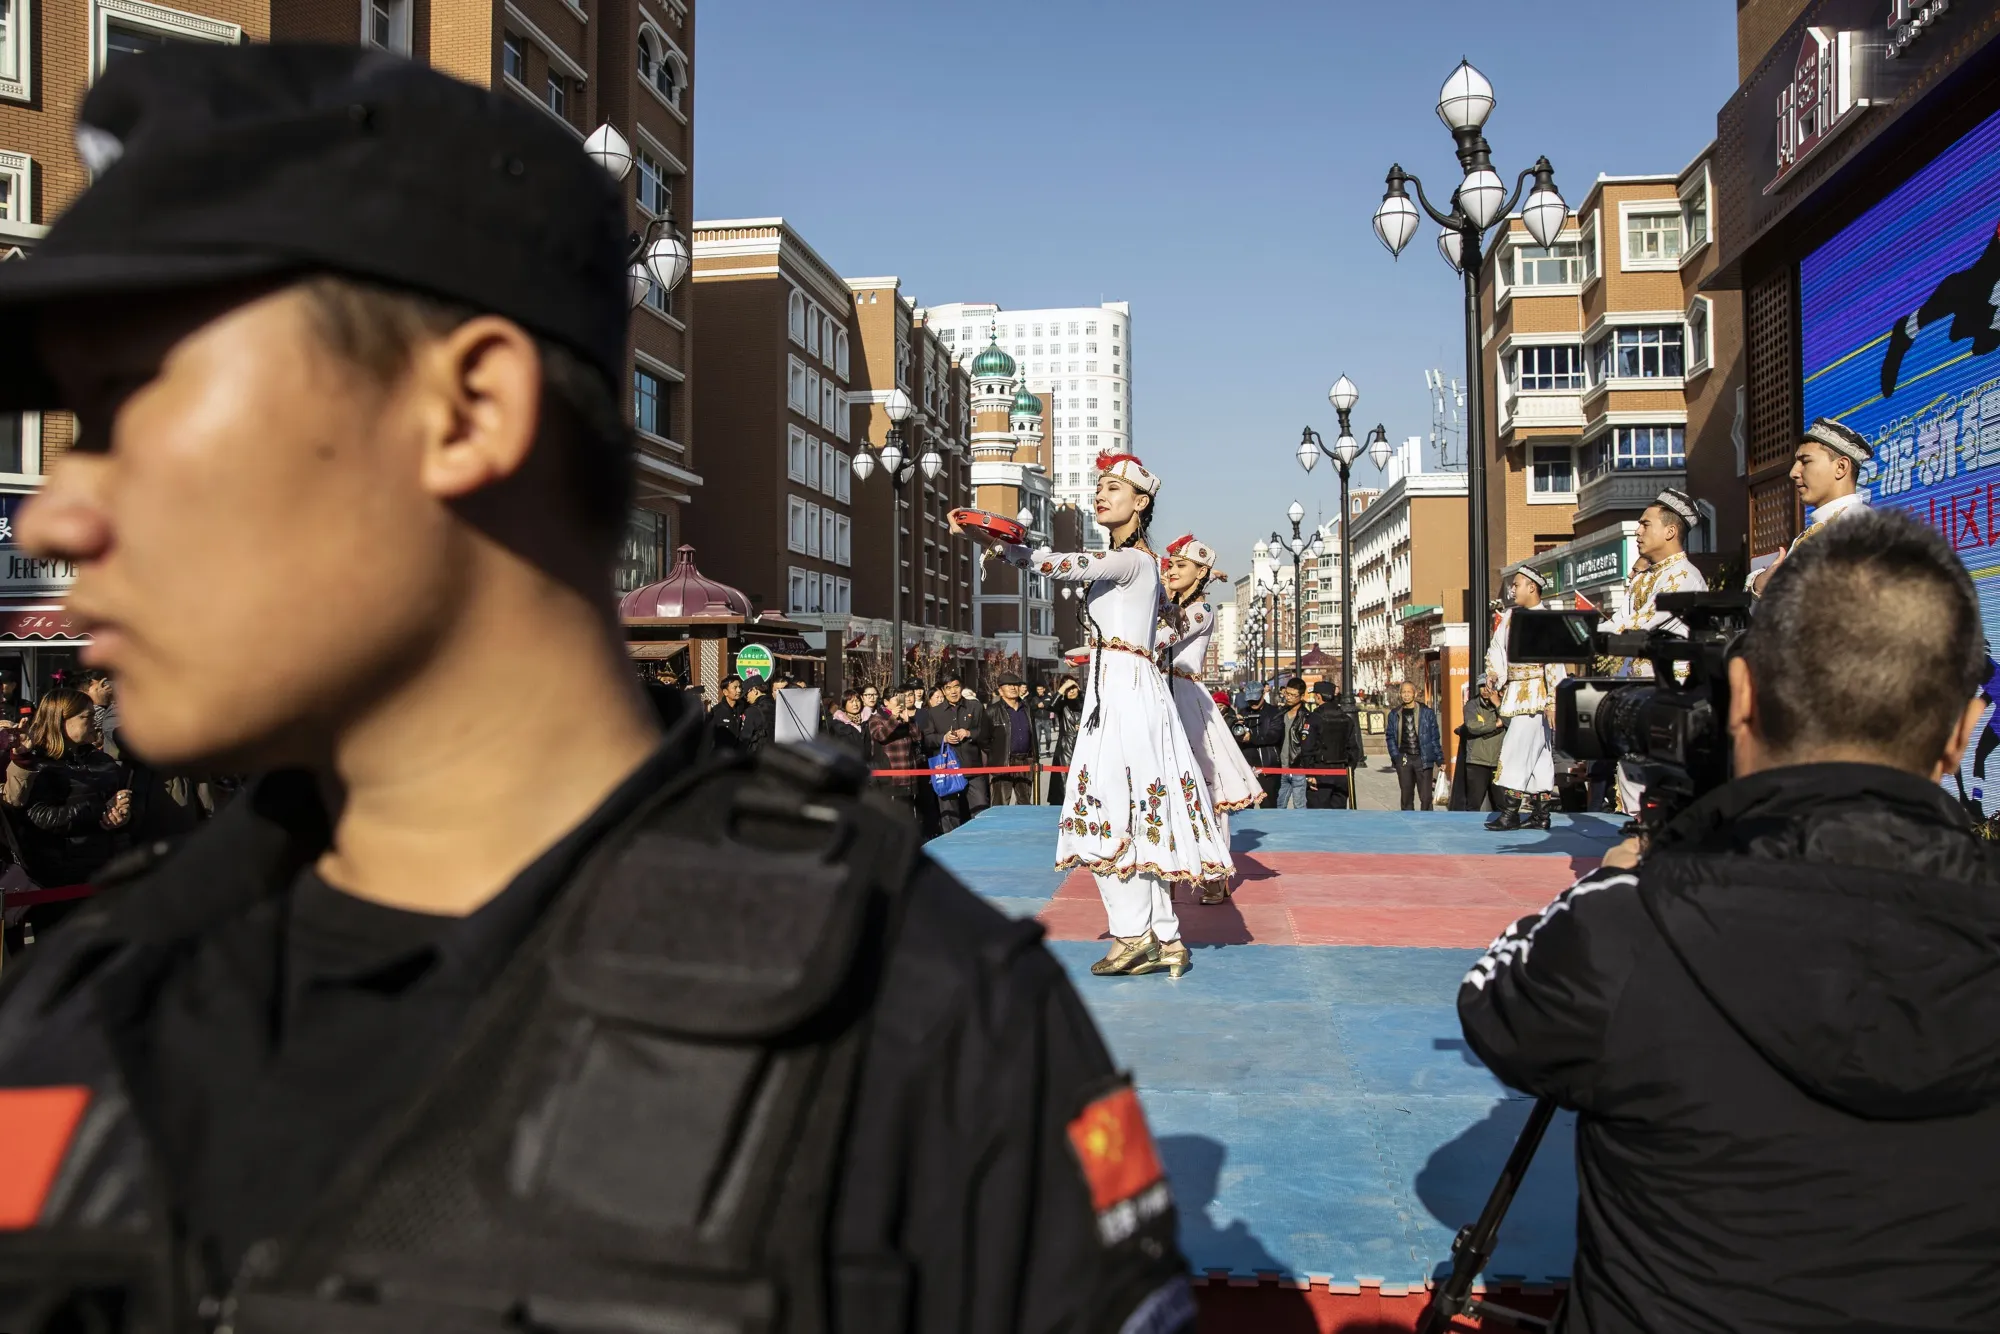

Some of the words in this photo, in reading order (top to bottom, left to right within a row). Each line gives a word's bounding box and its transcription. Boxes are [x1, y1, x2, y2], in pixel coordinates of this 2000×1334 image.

[6, 555, 58, 579] JEREMY
[61, 558, 80, 579] JE
[18, 616, 54, 628] The
